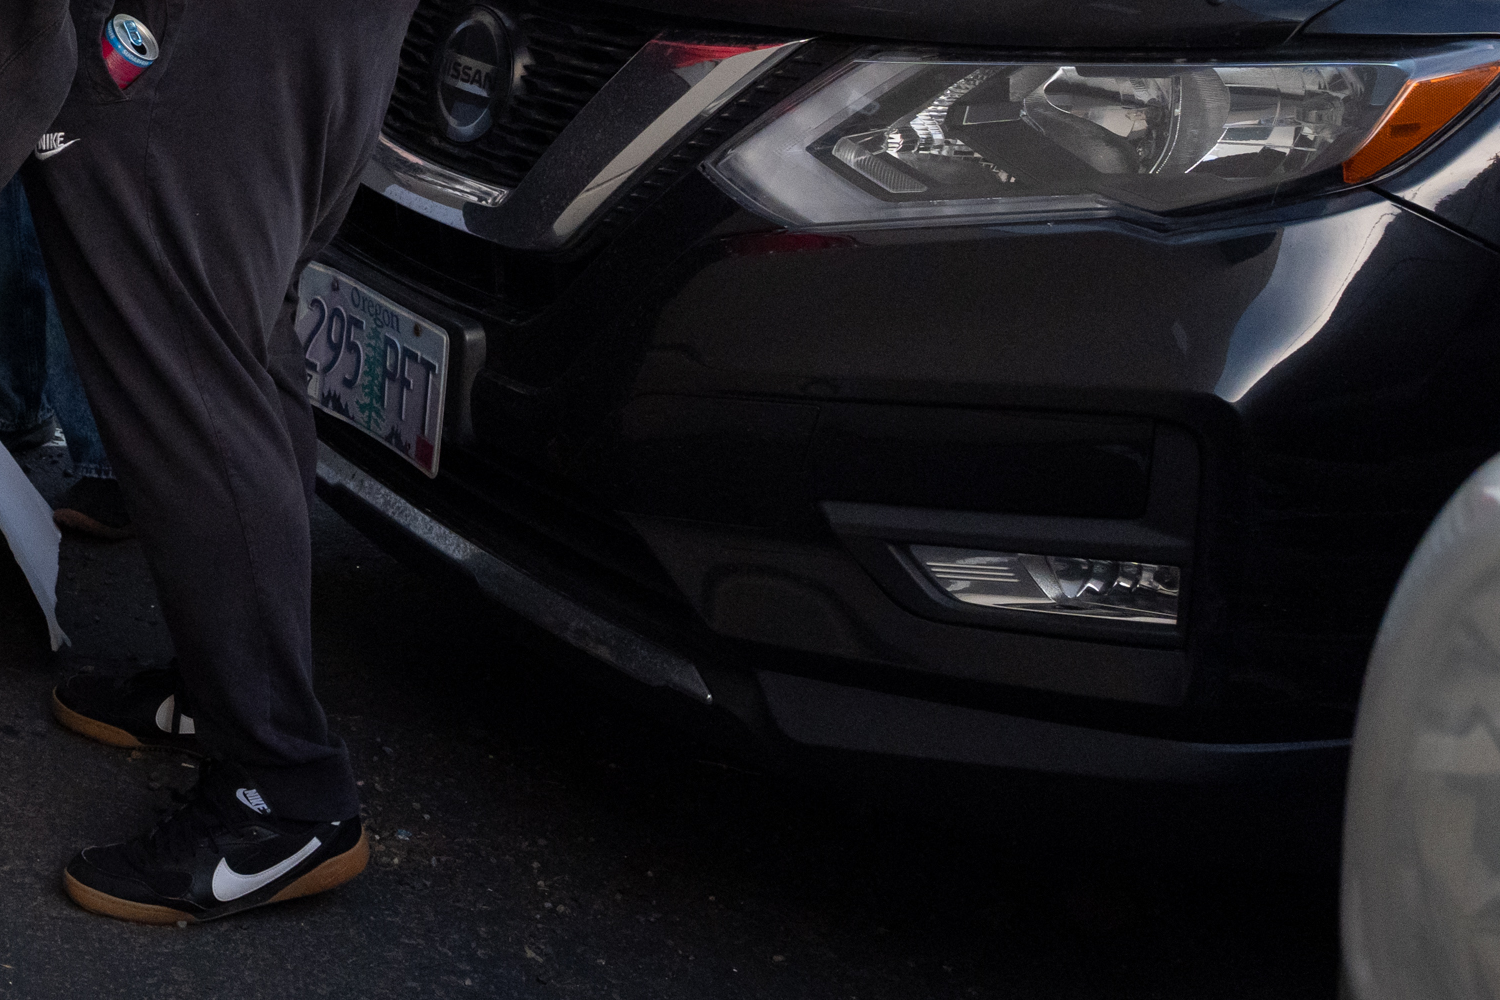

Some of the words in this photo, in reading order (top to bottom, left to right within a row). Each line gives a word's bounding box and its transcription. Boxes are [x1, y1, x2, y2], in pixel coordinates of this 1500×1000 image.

[446, 60, 496, 93] SSAN
[38, 132, 65, 150] NIKE
[350, 286, 400, 334] Oregon
[304, 295, 366, 390] 295
[382, 331, 439, 438] PFT
[243, 789, 269, 811] NIKE
